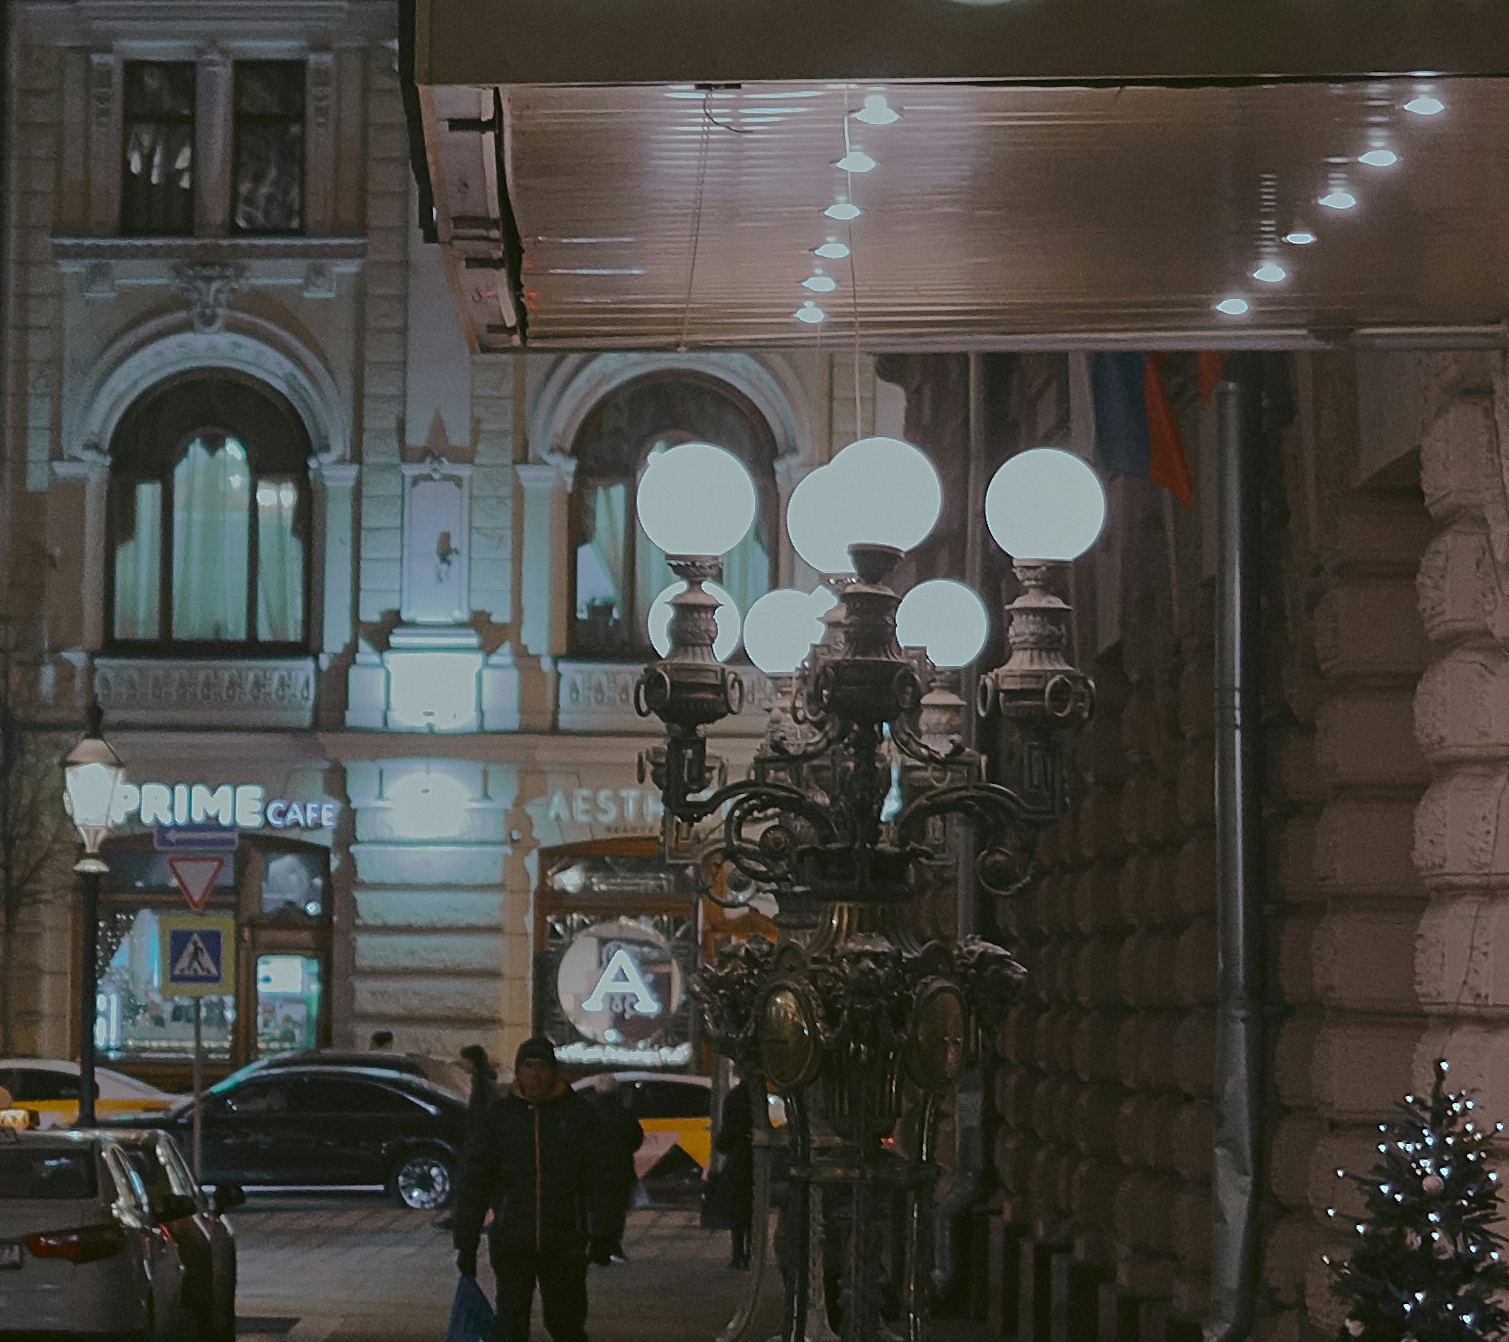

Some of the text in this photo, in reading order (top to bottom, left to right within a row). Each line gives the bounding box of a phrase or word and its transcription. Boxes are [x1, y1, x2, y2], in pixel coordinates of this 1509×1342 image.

[109, 784, 335, 829] PRIME CAFE
[581, 949, 663, 1014] A
